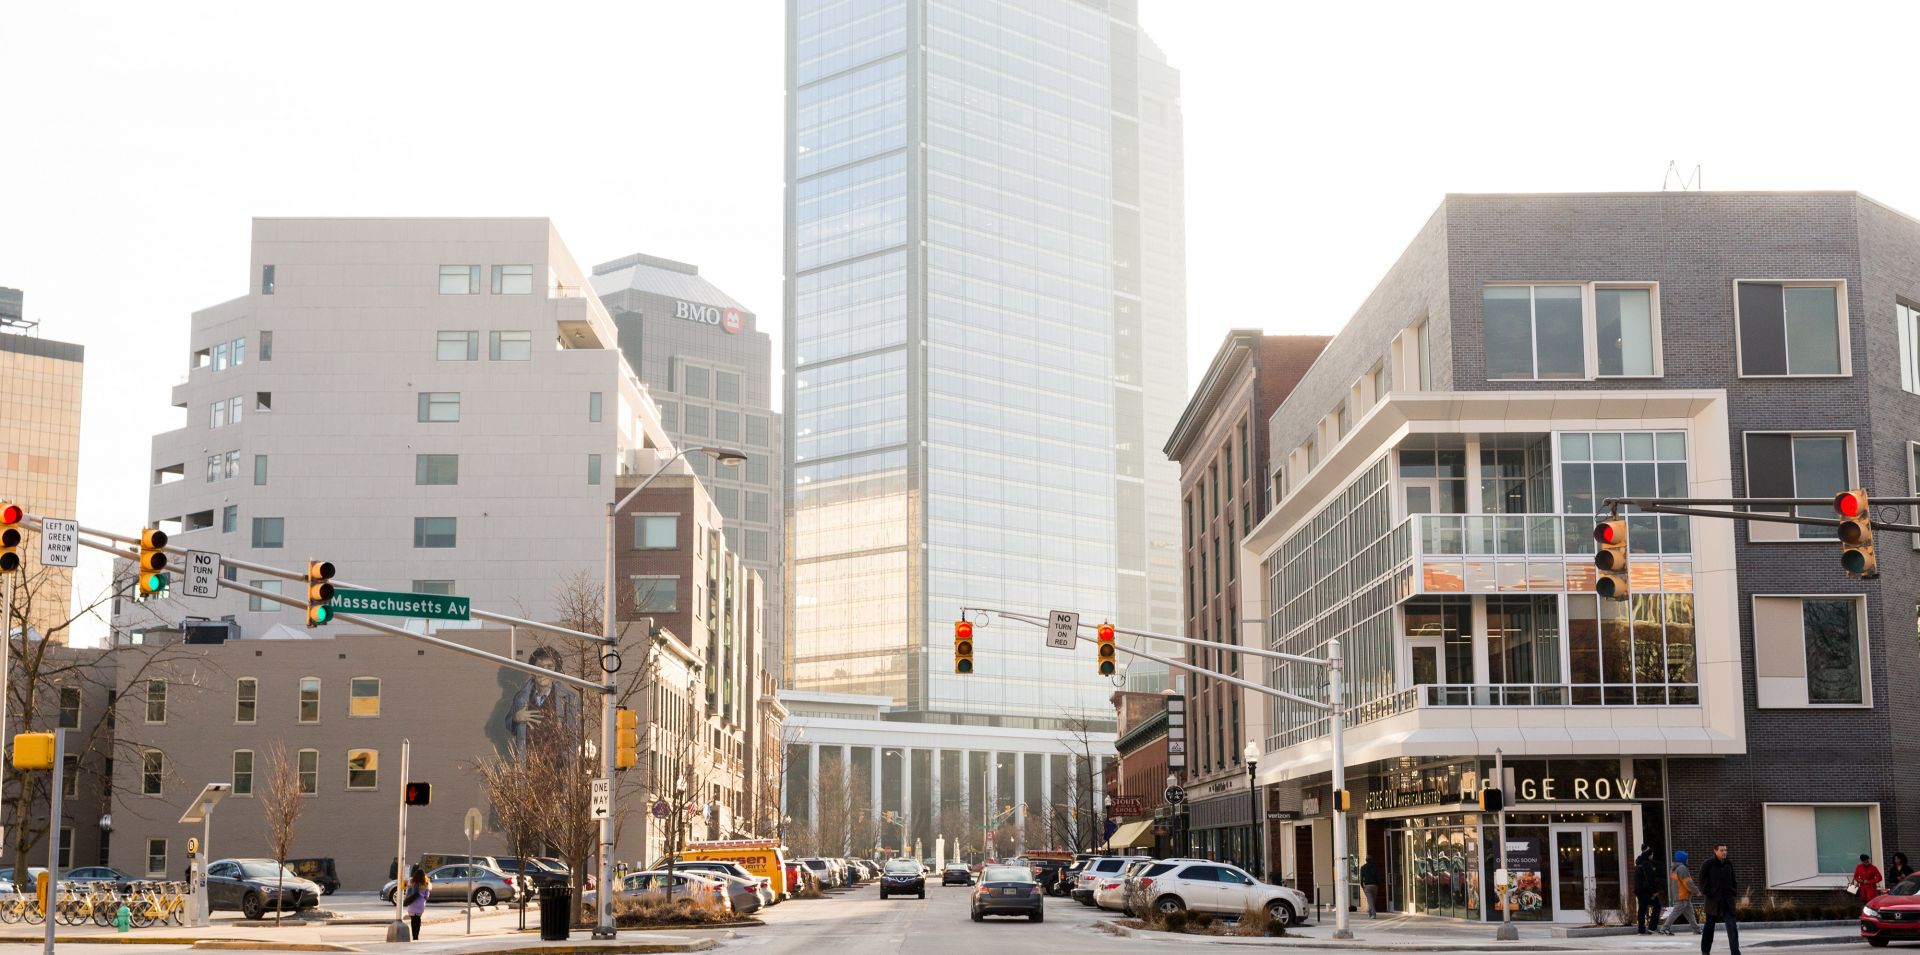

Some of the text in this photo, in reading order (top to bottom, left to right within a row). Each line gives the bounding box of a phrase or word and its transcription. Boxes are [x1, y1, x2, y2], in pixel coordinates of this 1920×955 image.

[676, 300, 720, 325] BMO
[45, 522, 75, 532] LEFT ON
[48, 533, 72, 542] GREEN
[47, 544, 72, 552] ARROW
[50, 554, 68, 563] ONLY
[195, 555, 211, 565] NO
[192, 565, 213, 575] TURN
[196, 576, 208, 584] ON
[192, 585, 208, 594] RED
[331, 594, 467, 615] Massachusetts Av
[1057, 614, 1071, 622] NO
[1055, 623, 1072, 631] TURN
[1054, 638, 1068, 646] RED
[593, 783, 608, 793] ONE
[1460, 778, 1637, 800] HGE ROW
[593, 796, 609, 805] WAY
[1366, 790, 1383, 810] HEDGE
[1398, 793, 1422, 807] AMERICAN
[1423, 790, 1441, 804] BISTRO
